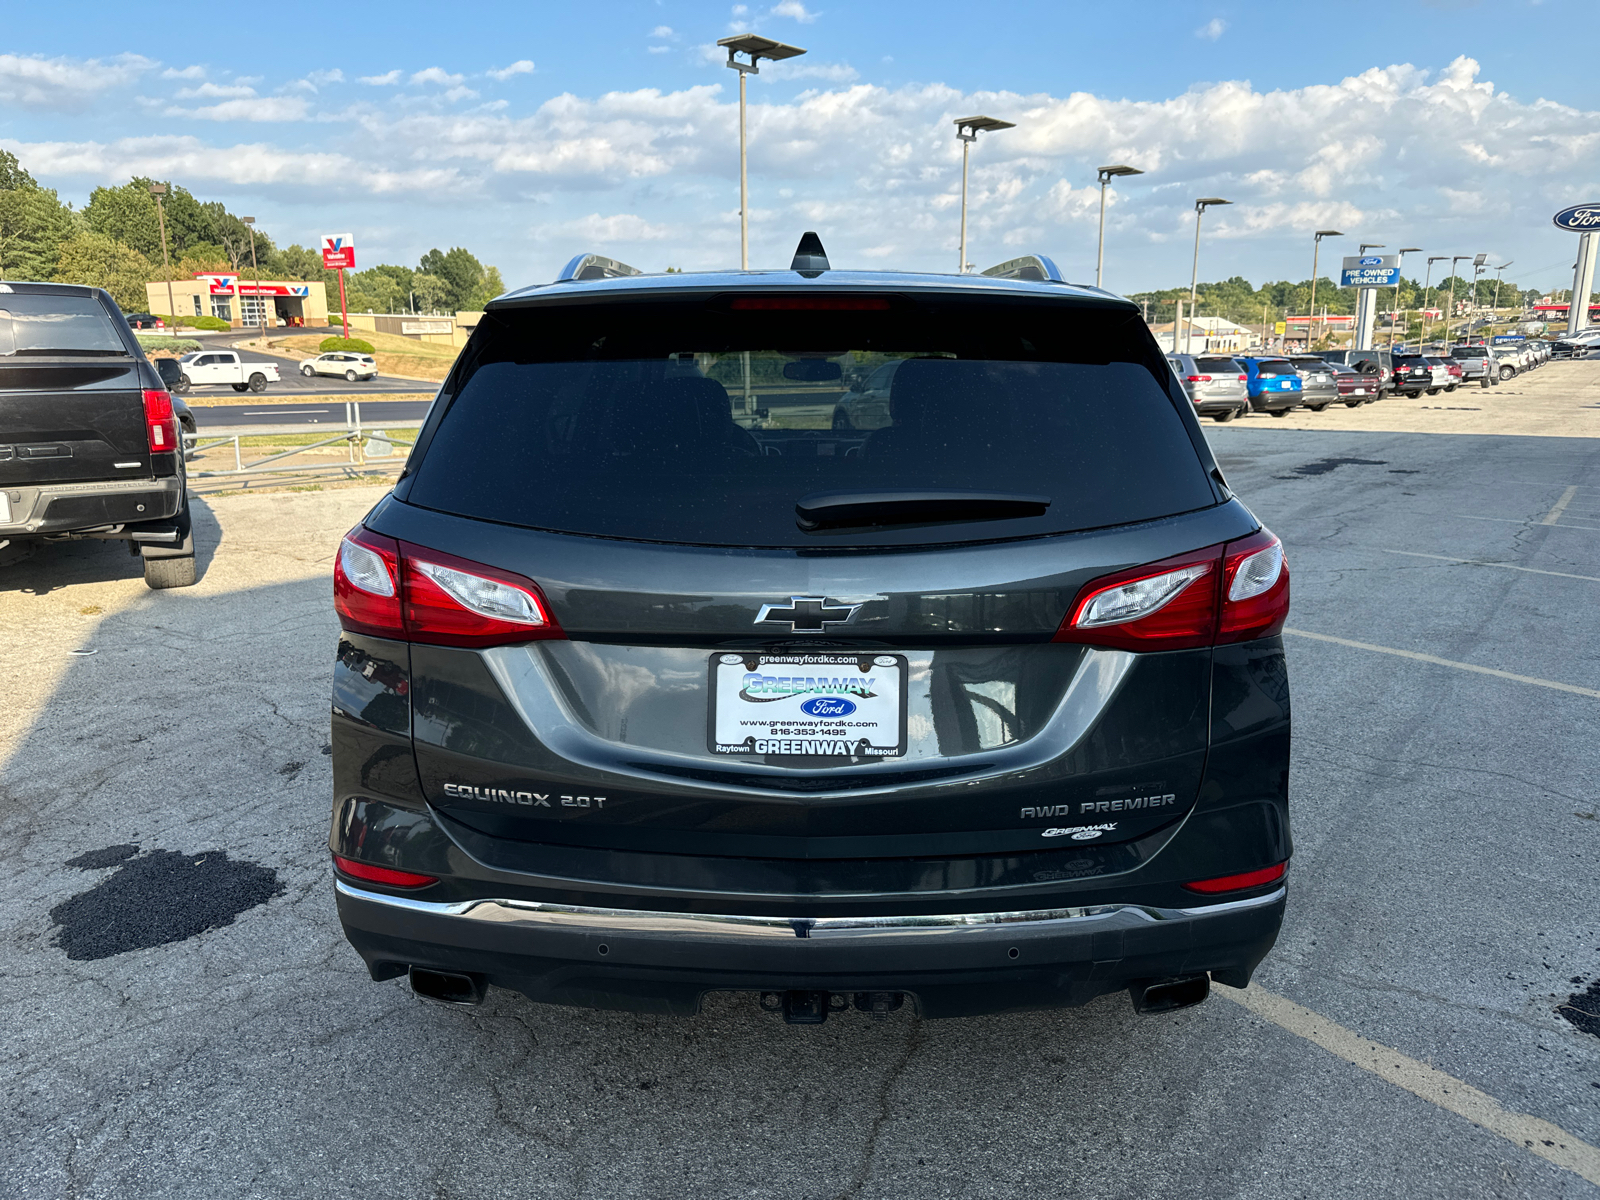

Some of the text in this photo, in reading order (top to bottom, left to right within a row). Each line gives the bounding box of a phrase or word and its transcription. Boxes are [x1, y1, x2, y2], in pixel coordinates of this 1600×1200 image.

[1568, 208, 1600, 226] For
[1362, 258, 1378, 266] Ford
[1345, 268, 1394, 278] PRE-OWNED
[1350, 276, 1388, 284] VEHICLES
[759, 654, 858, 666] greenwayfordkc.com
[742, 673, 876, 695] GREENWAY
[812, 699, 844, 715] Ford
[740, 719, 878, 728] www.greenwayfordkc.com
[770, 728, 847, 736] 816-353-1495
[716, 745, 750, 754] Raytown
[754, 739, 859, 755] GREENWAY
[864, 747, 899, 756] Missouri
[443, 783, 551, 808] EQUINOX
[1020, 793, 1175, 819] AWD PREMIER
[1043, 822, 1118, 836] GREENWAY
